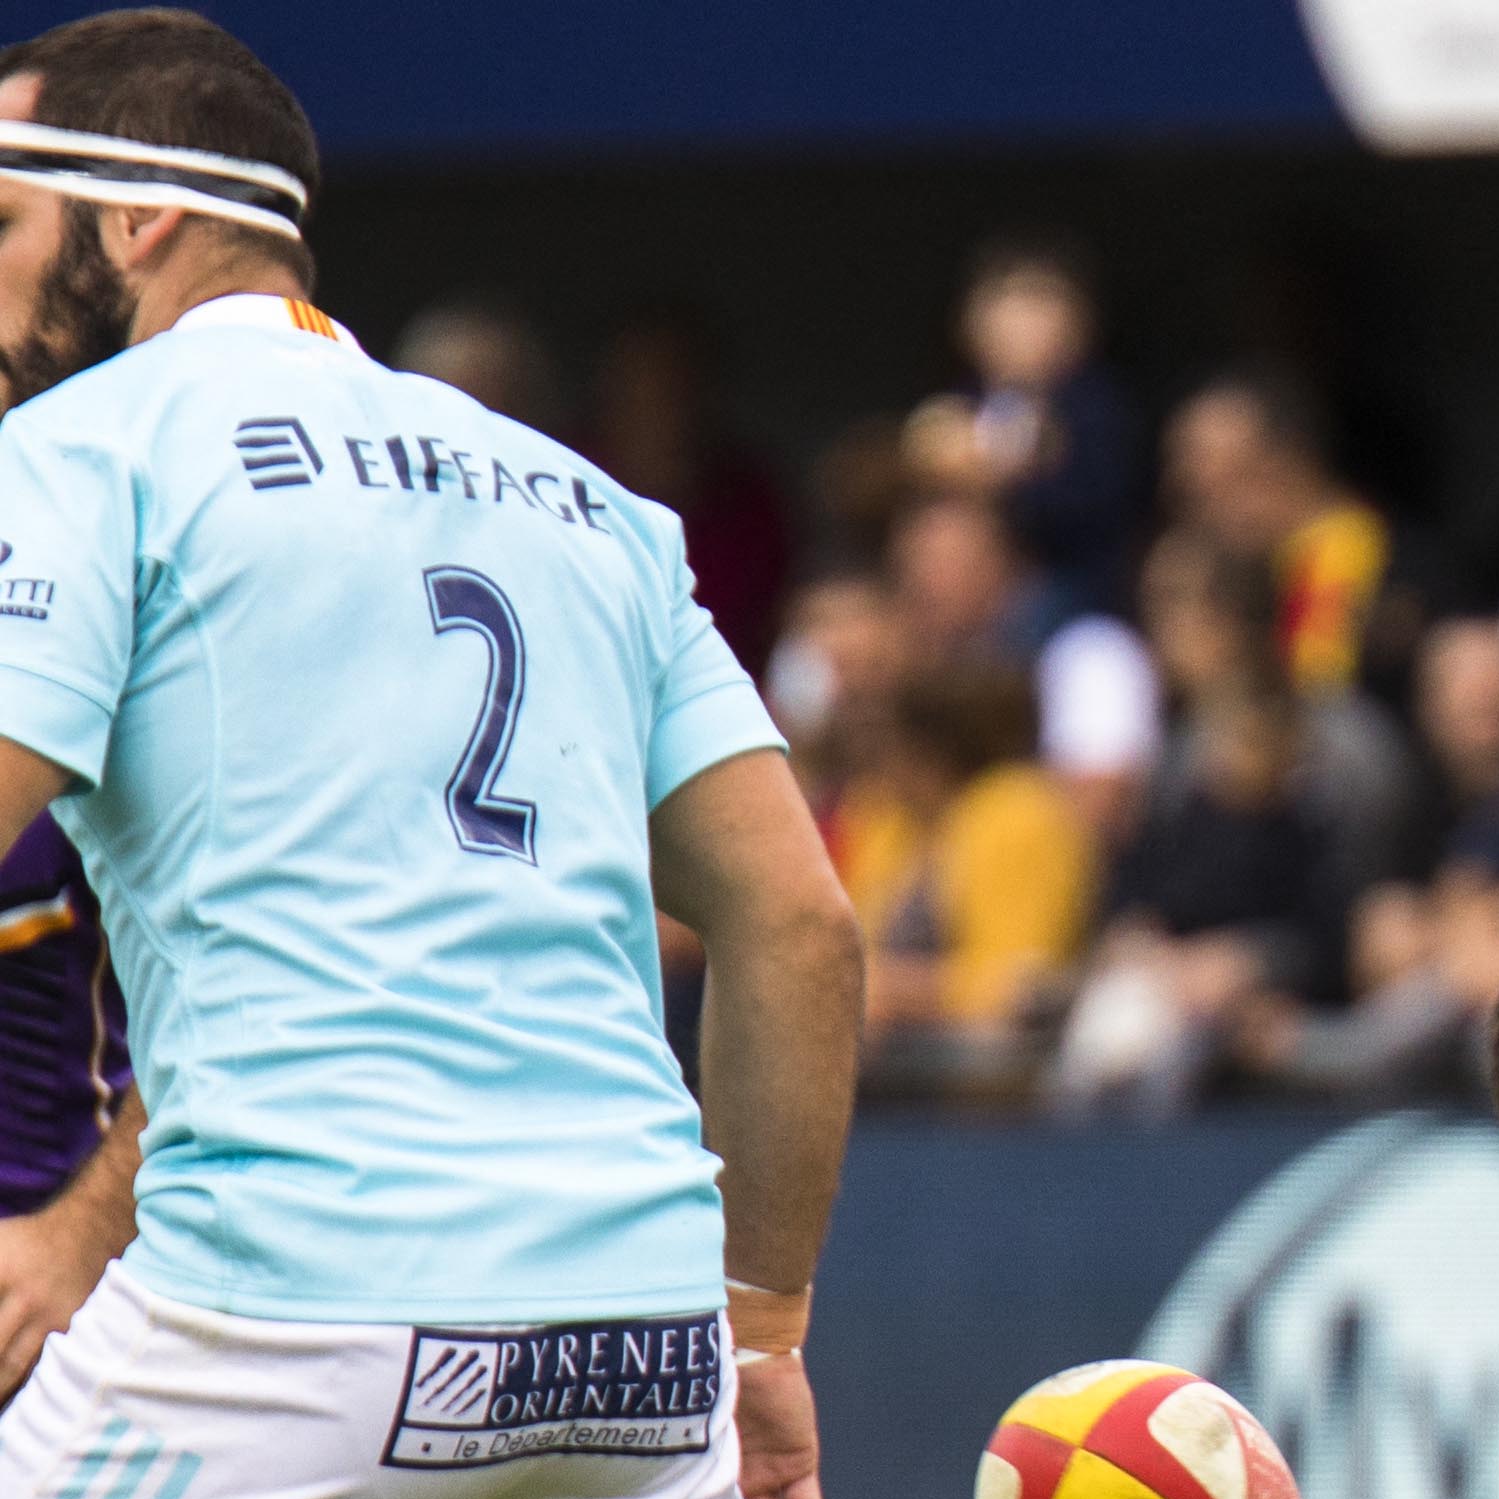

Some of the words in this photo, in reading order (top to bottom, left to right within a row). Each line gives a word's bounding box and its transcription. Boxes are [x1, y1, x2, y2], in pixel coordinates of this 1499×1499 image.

[343, 434, 611, 535] EIFFAGE
[422, 563, 539, 867] 2
[490, 1374, 718, 1425] ORIENTALES
[452, 1433, 482, 1460] le
[488, 1421, 669, 1457] Département
